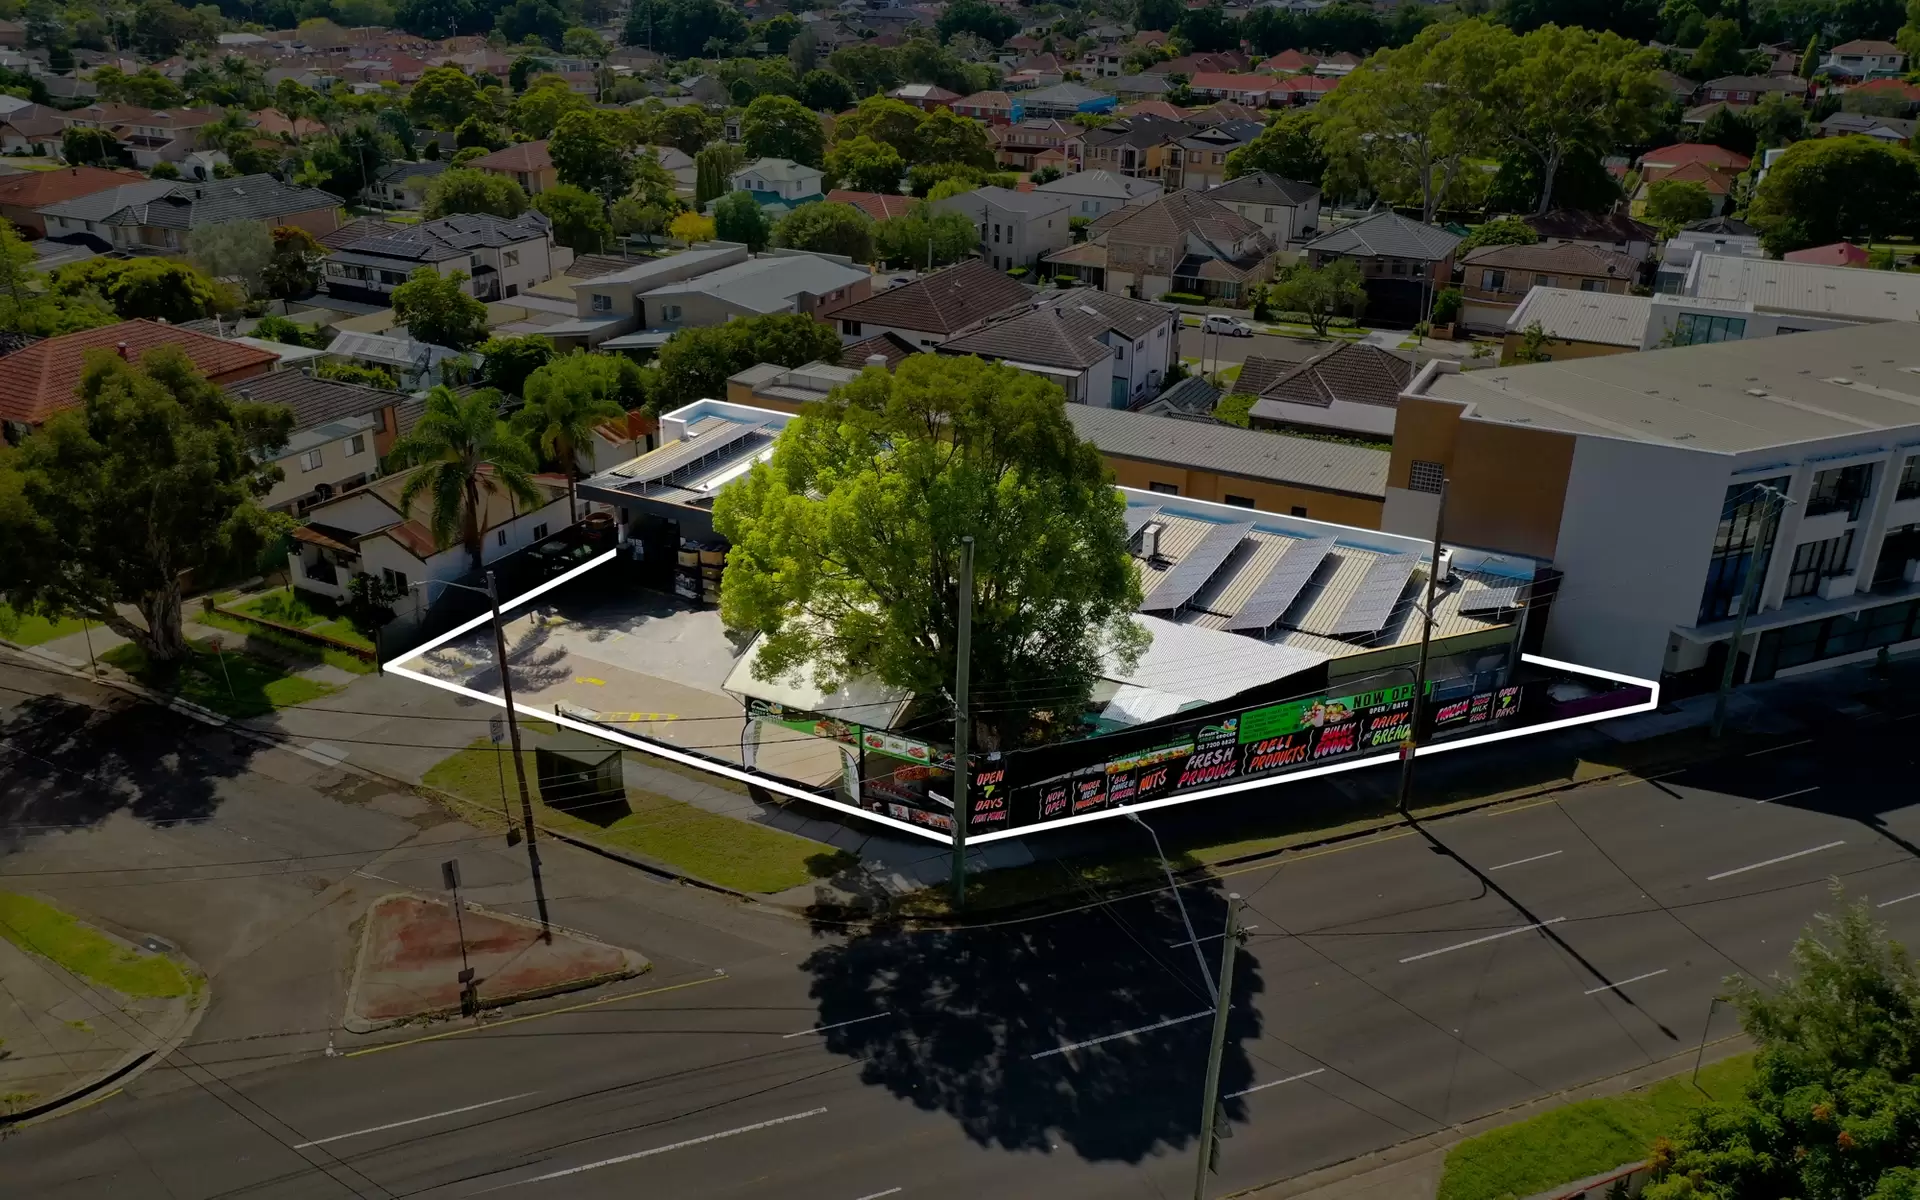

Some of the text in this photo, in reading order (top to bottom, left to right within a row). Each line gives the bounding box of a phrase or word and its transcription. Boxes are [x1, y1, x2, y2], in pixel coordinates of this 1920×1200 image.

[1353, 682, 1427, 708] NOW OPE
[1499, 686, 1518, 698] OPEN
[1369, 704, 1385, 714] OPEN
[1392, 701, 1408, 710] DAYS
[1471, 704, 1488, 713] MILK
[1502, 696, 1513, 708] 7
[1435, 699, 1469, 722] FROZEN
[1496, 706, 1516, 718] DAYS
[1370, 711, 1409, 730] DAIRY
[1216, 732, 1236, 740] GROCER
[1320, 722, 1356, 742] BULKY
[1371, 723, 1412, 746] BREAD
[1206, 741, 1220, 749] 7200
[1256, 735, 1294, 756] DELI
[1313, 735, 1355, 759] GOODS
[1186, 747, 1235, 770] FRESH
[1248, 744, 1307, 773] PRODUCTS
[976, 770, 1005, 786] OPEN
[1114, 774, 1127, 785] BIG
[1138, 768, 1168, 794] NUTS
[1177, 760, 1238, 788] PRODUCE
[983, 785, 996, 798] 7
[1080, 780, 1100, 792] UNDER
[1081, 788, 1098, 800] NEW
[1110, 781, 1128, 793] RANGE
[1046, 788, 1066, 804] NOW
[974, 798, 1003, 811] DAYS
[1045, 797, 1067, 815] OPEN
